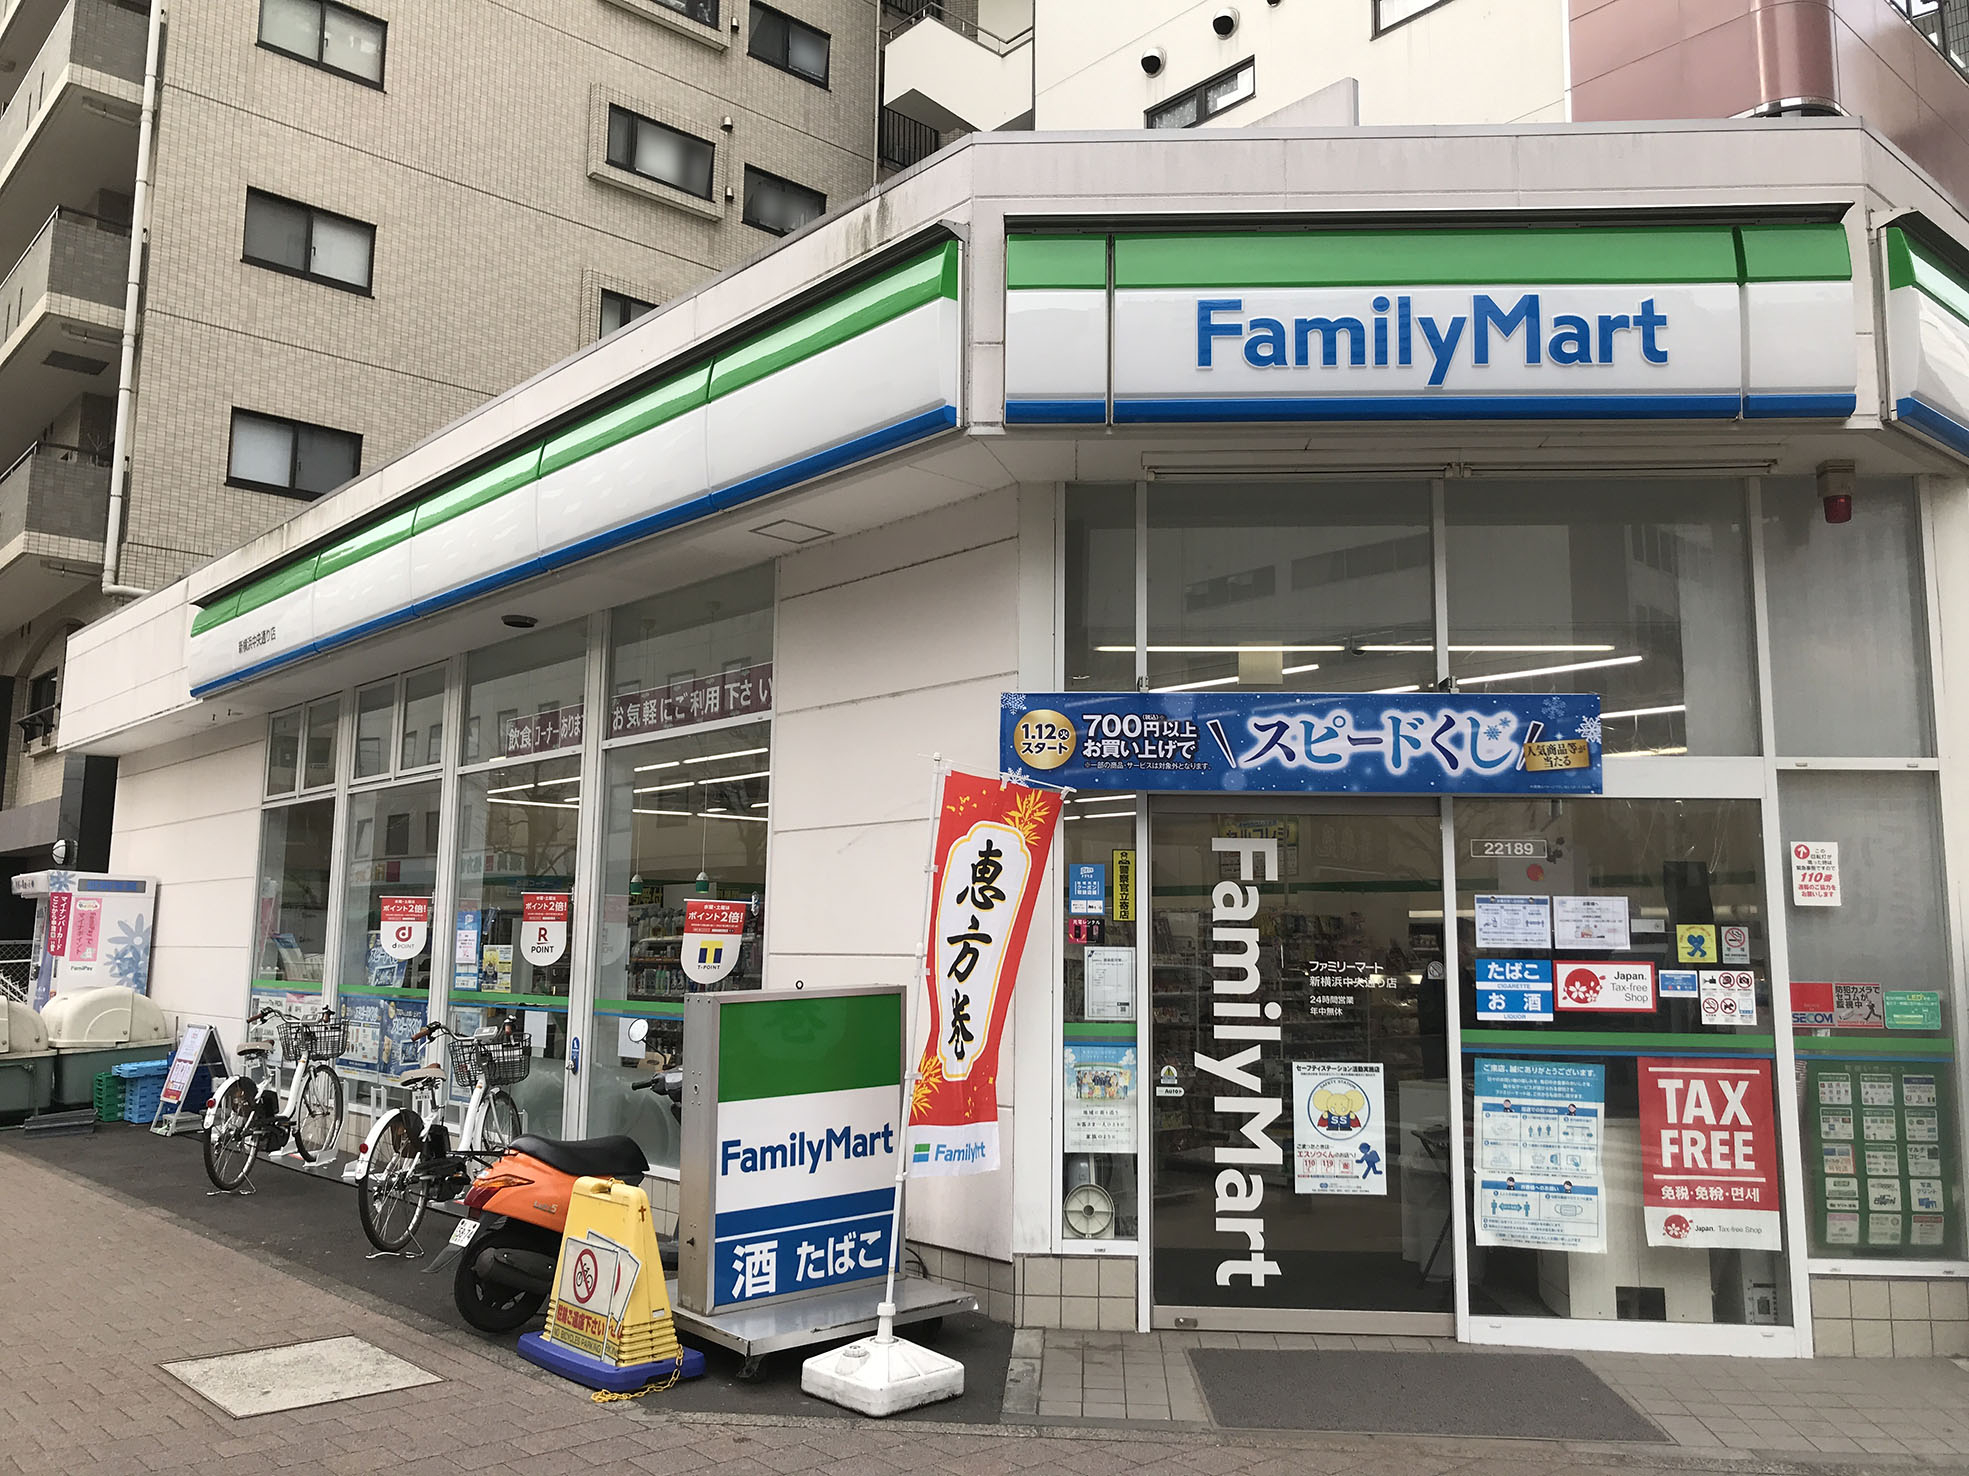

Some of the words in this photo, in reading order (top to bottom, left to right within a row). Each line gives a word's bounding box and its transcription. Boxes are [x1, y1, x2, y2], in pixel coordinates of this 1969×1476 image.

[1196, 294, 1669, 388] FamilyMart
[1243, 713, 1514, 770] スピードくじ
[1021, 742, 1070, 755] スタート
[1082, 739, 1197, 760] お買い上げで
[1543, 755, 1572, 768] 当たる
[1483, 842, 1534, 855] 22189
[1801, 872, 1833, 883] 110番
[383, 904, 427, 914] ポイント2倍!
[525, 901, 567, 912] ポイント2倍!
[688, 911, 744, 923] ポイント2倍!
[537, 927, 548, 942] R
[531, 945, 555, 954] POINT
[945, 838, 1006, 1062] 恵方巻
[1309, 961, 1384, 974] ファミリーマート
[1487, 961, 1540, 980] たばこ
[1309, 976, 1398, 989] 新横浜中央通り店
[1614, 971, 1647, 981] Japan.
[1610, 982, 1648, 992] Tax-free
[1835, 985, 1880, 994] 防犯カメラで
[1309, 995, 1354, 1005] 24時間営業
[1624, 993, 1648, 1003] Shop
[1835, 993, 1868, 1001] セコムが
[1836, 1000, 1863, 1009] 監視中
[1309, 1007, 1343, 1016] 年中無休
[1791, 1012, 1833, 1024] SECOM
[1194, 837, 1282, 1287] FamilyMart
[1320, 1080, 1337, 1089] SAFETY
[1338, 1080, 1357, 1090] STATION
[1657, 1079, 1752, 1126] TAX
[721, 1122, 894, 1177] FamilyMart
[1660, 1129, 1756, 1170] FREE
[1718, 1225, 1744, 1233] Tax-free
[1745, 1226, 1763, 1235] Shop
[731, 1239, 779, 1299] 酒
[796, 1229, 883, 1283] たばこ
[560, 1329, 581, 1346] BICYCLES
[581, 1337, 602, 1354] PARKING
